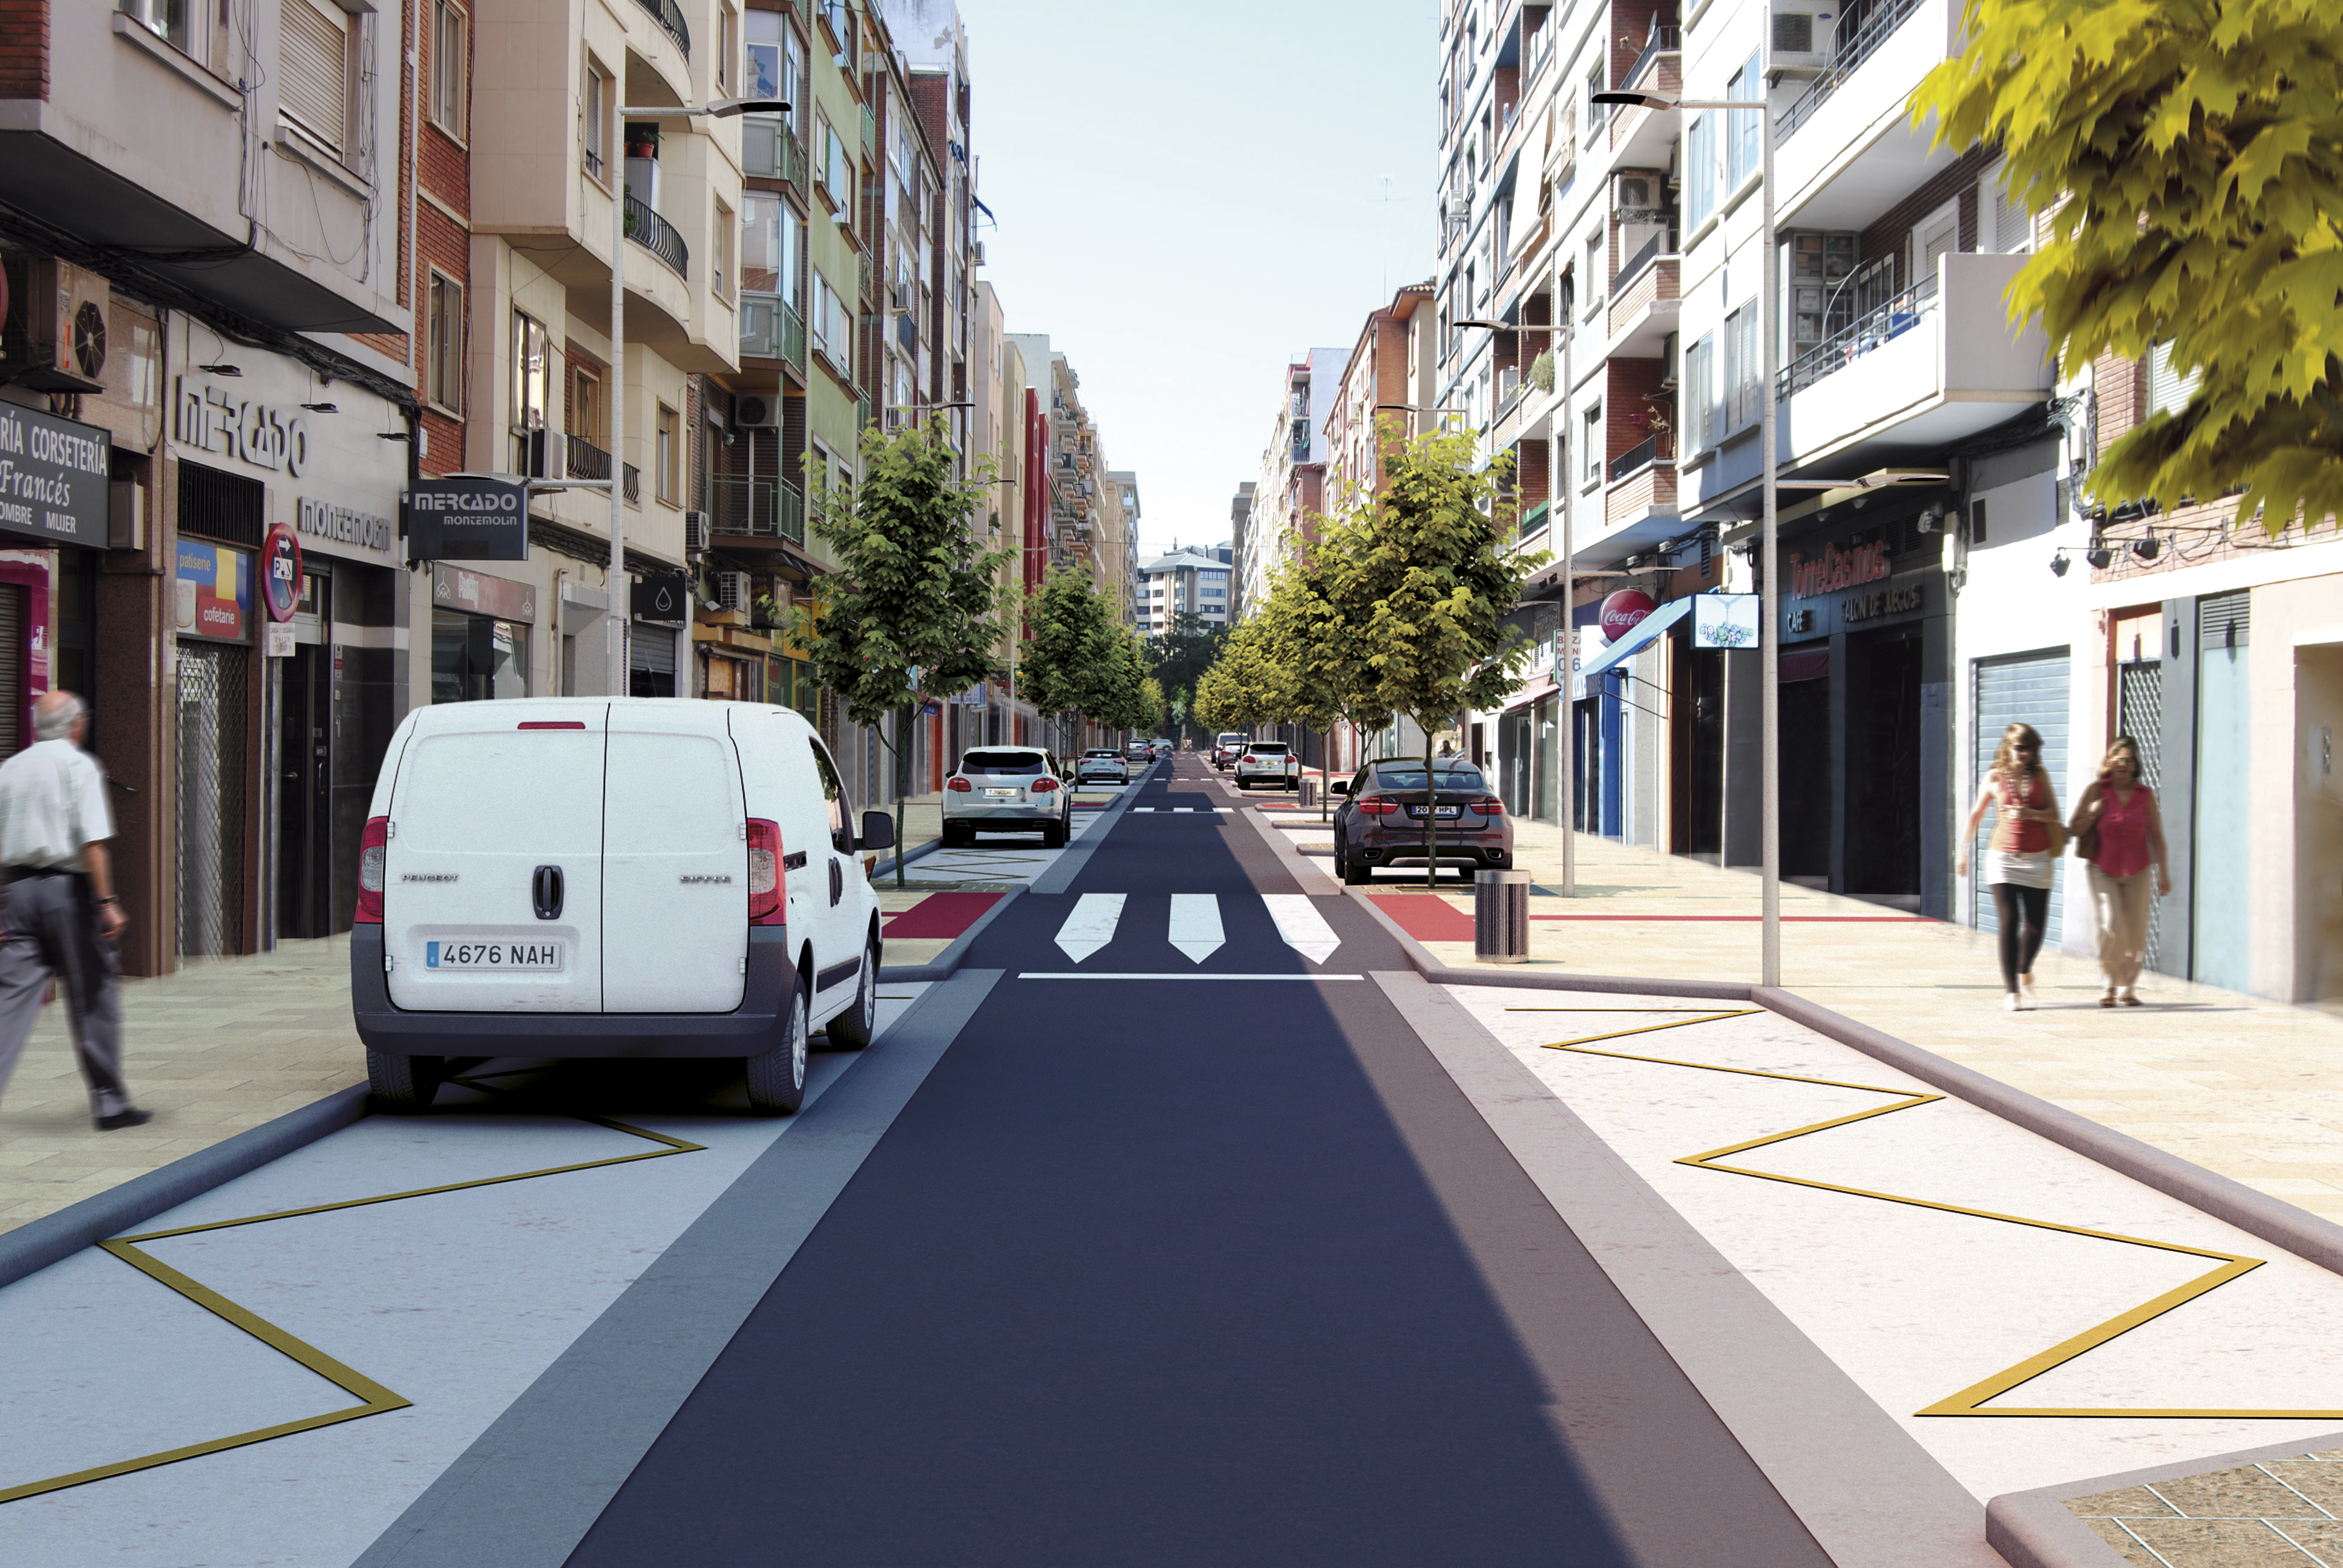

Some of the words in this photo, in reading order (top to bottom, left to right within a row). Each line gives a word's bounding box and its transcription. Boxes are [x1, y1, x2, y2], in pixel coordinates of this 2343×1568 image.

[176, 374, 310, 479] MERCADO
[32, 425, 108, 476] CORSETERÍA
[0, 459, 71, 507] Francés
[415, 493, 517, 511] MERCADO
[46, 511, 76, 534] MUJER
[180, 553, 211, 572] patiserie
[1789, 540, 1886, 601] TorreCasinos
[204, 607, 235, 625] cofetarie
[1604, 609, 1653, 626] Coca-Col
[444, 945, 502, 964] 4676
[511, 946, 554, 964] NAH
